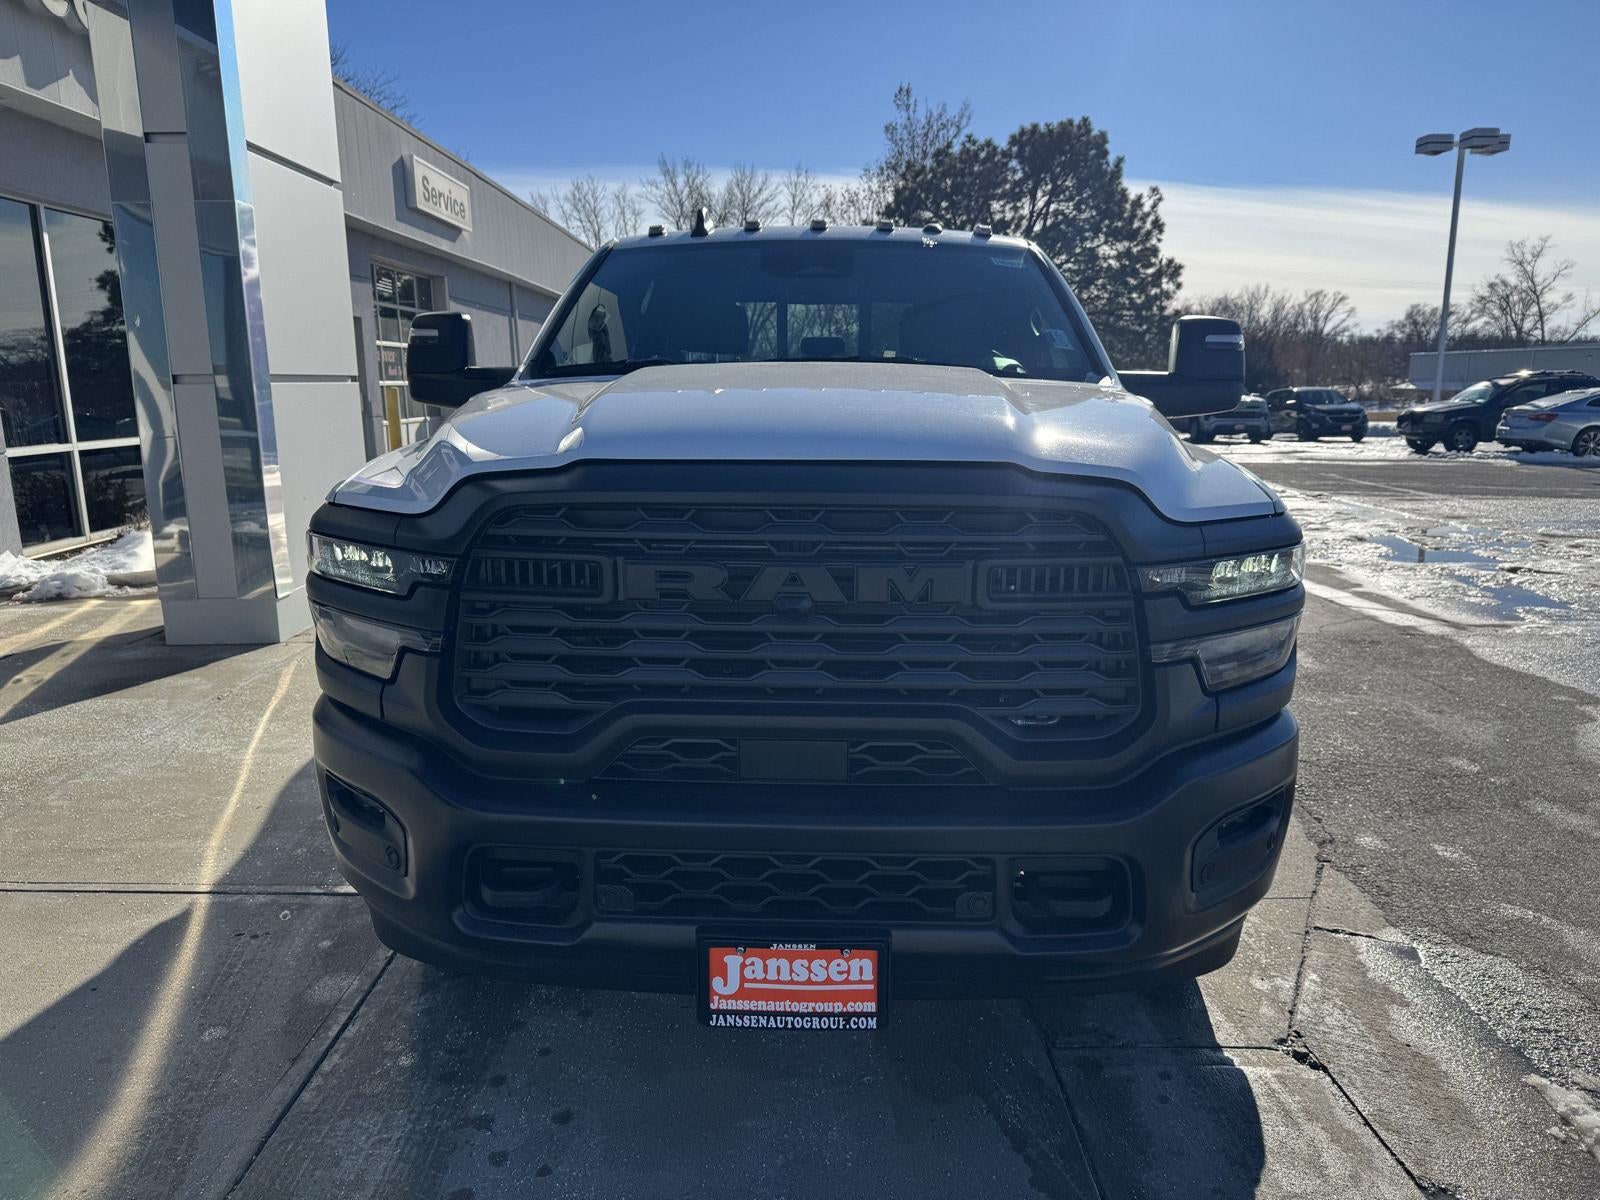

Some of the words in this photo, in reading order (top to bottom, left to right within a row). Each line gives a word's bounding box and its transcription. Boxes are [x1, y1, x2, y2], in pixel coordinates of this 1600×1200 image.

[421, 175, 466, 220] Service
[623, 560, 970, 604] RAM
[712, 955, 874, 995] Janssen
[710, 996, 876, 1013] Janssenautogroup.com
